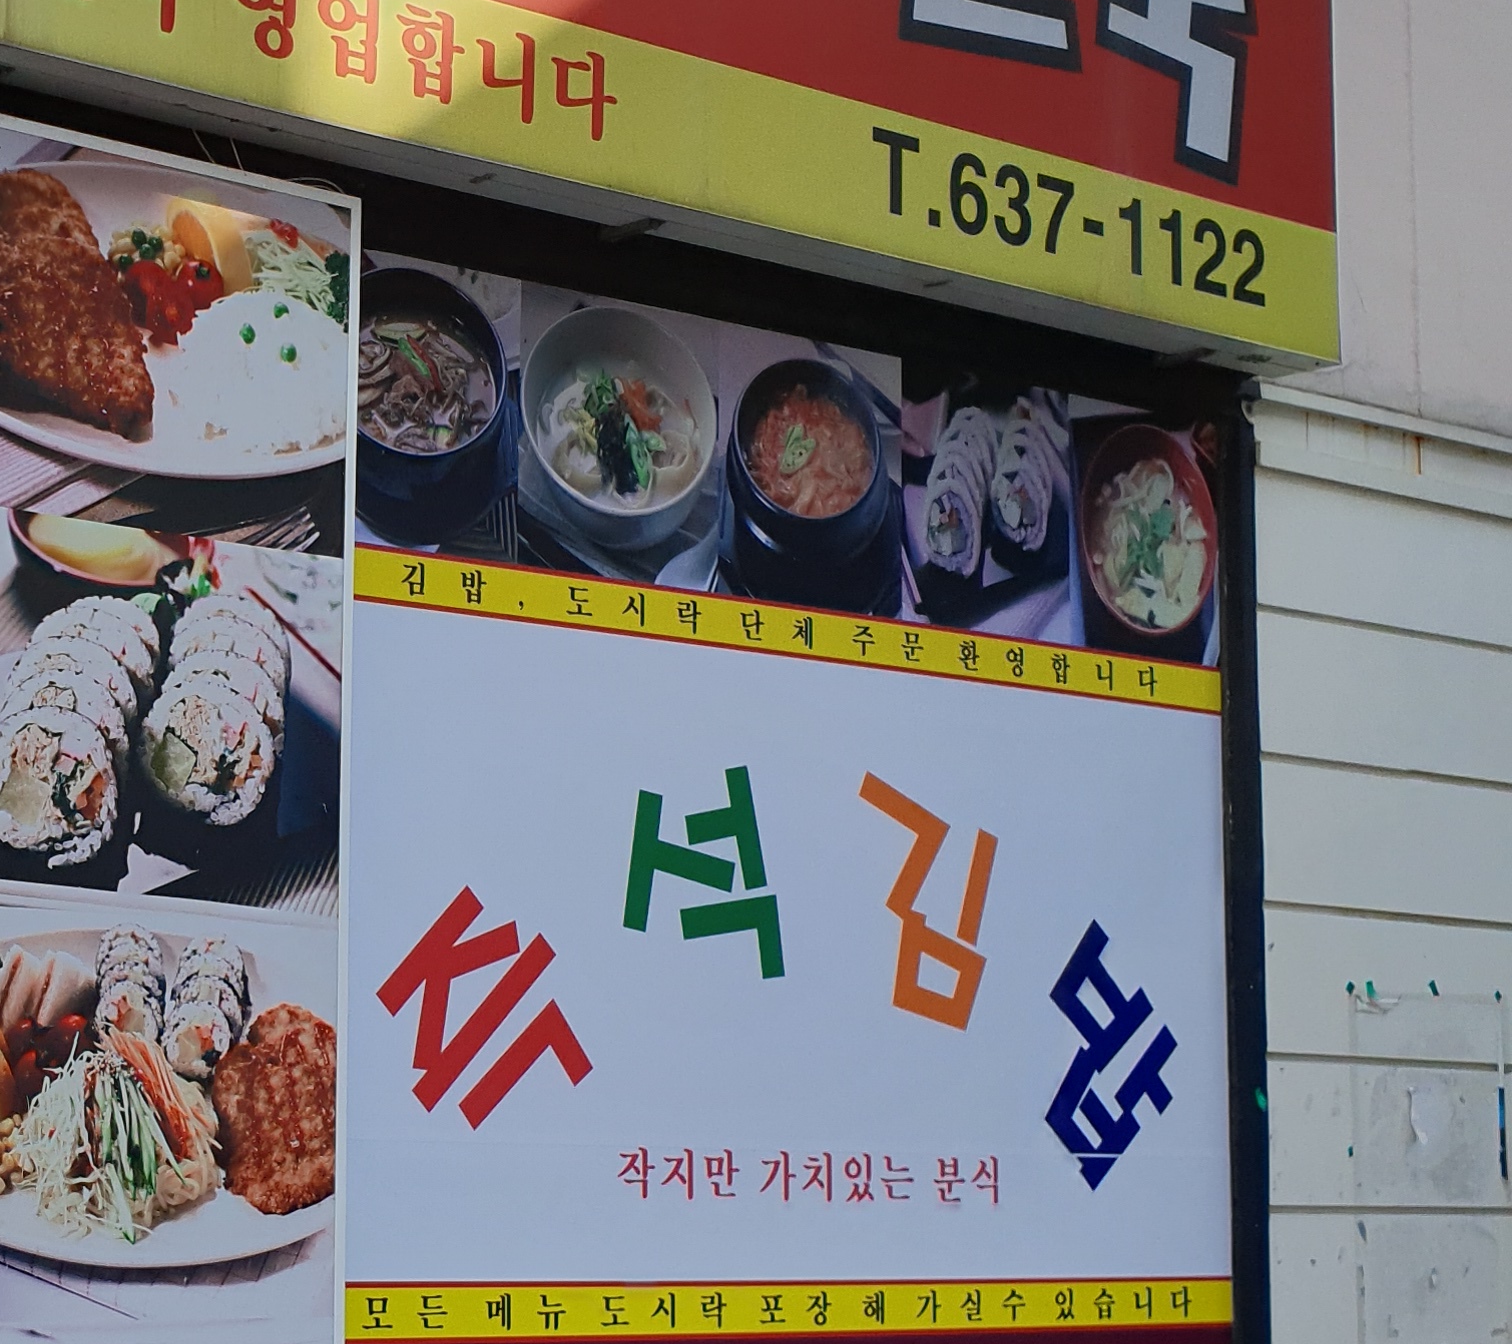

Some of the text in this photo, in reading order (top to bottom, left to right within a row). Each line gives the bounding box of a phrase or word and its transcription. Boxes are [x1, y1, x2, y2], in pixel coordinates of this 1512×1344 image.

[873, 128, 1267, 307] T.637-1122
[566, 580, 702, 637] 도시락
[740, 608, 816, 649] 단체
[850, 622, 925, 663] 주문
[958, 639, 1159, 699] 환영합니다
[375, 764, 786, 1131] 즉석
[858, 770, 1178, 1192] 김밥
[616, 1148, 1002, 1206] 작지만 가치있는 분식
[362, 1284, 1195, 1331] 모든 메뉴 도시락 포장 해 가실수 있습니다
